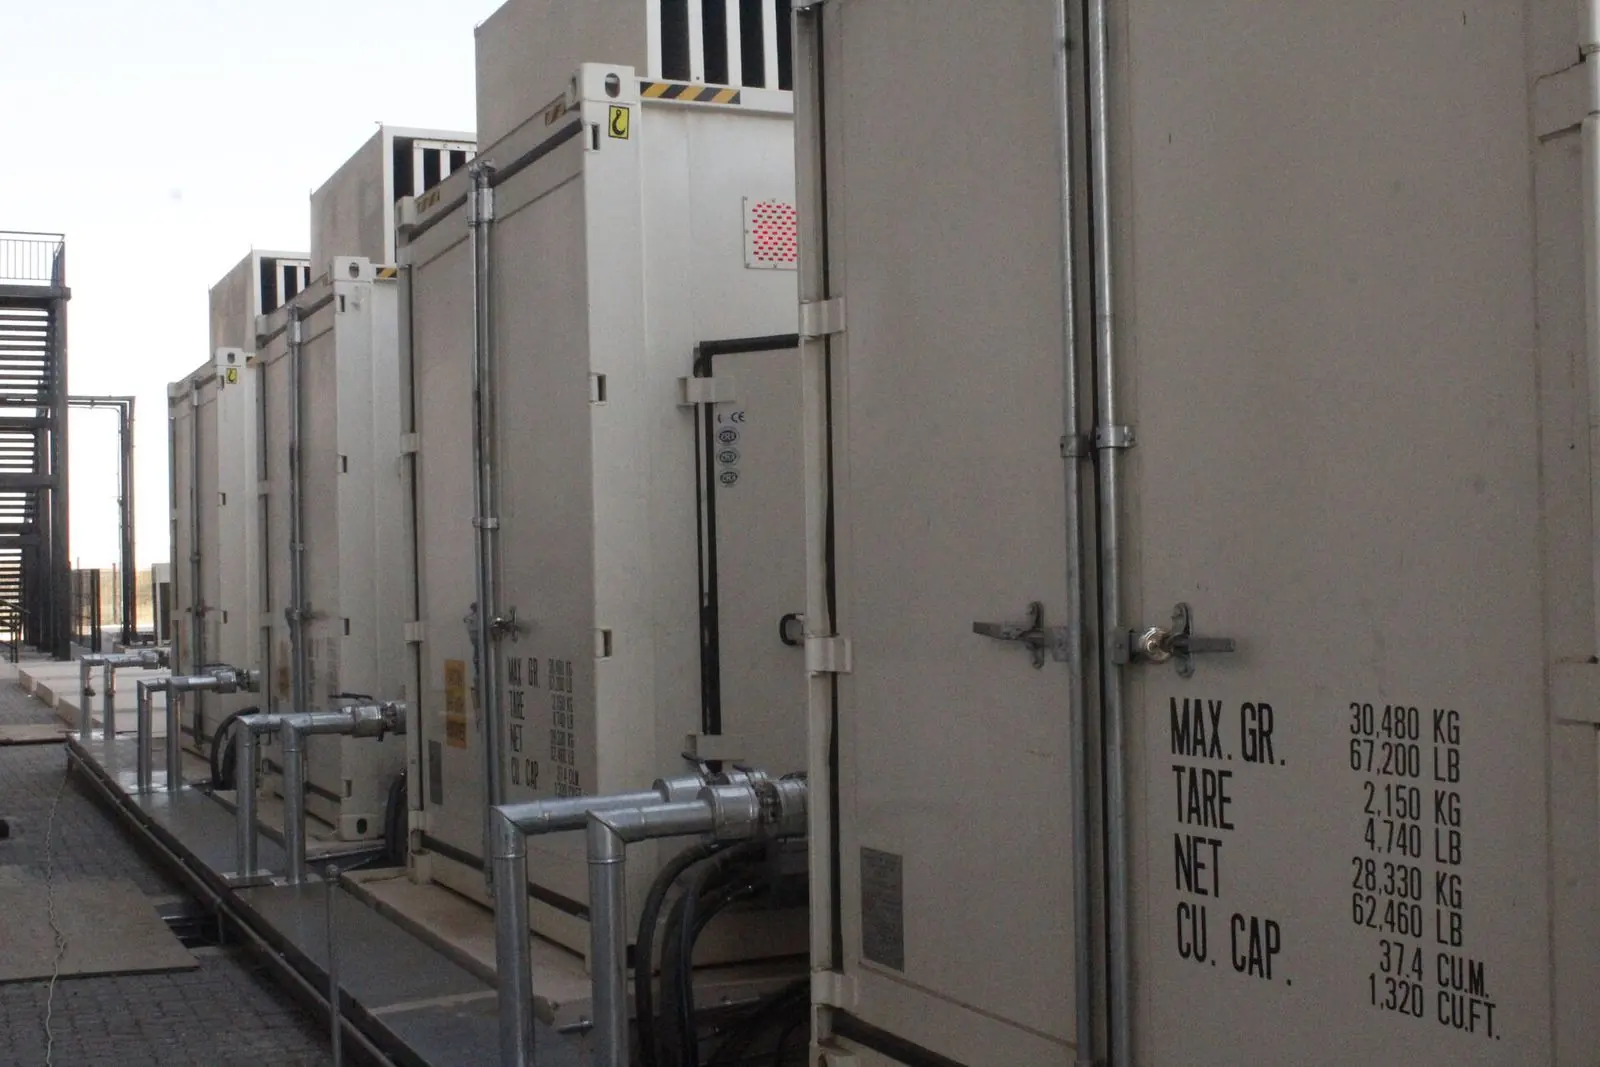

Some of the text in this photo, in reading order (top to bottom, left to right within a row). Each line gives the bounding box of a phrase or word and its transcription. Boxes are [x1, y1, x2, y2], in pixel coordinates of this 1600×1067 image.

[1170, 697, 1285, 766] MAX. GR.
[1350, 702, 1460, 745] 30,480 KG
[1350, 738, 1460, 783] 67,200 LB
[1172, 765, 1234, 831] TARE
[1364, 781, 1461, 827] 2,150 KG
[1174, 833, 1222, 898] NET
[1435, 828, 1461, 865] LB
[1352, 856, 1462, 909] 28,330 KG
[1177, 902, 1291, 986] CU. CAP.
[1353, 892, 1462, 947] 62,460 LB
[1379, 939, 1489, 998] 37.4 CU.M.
[1369, 973, 1500, 1040] 1,320 CU.FT.
